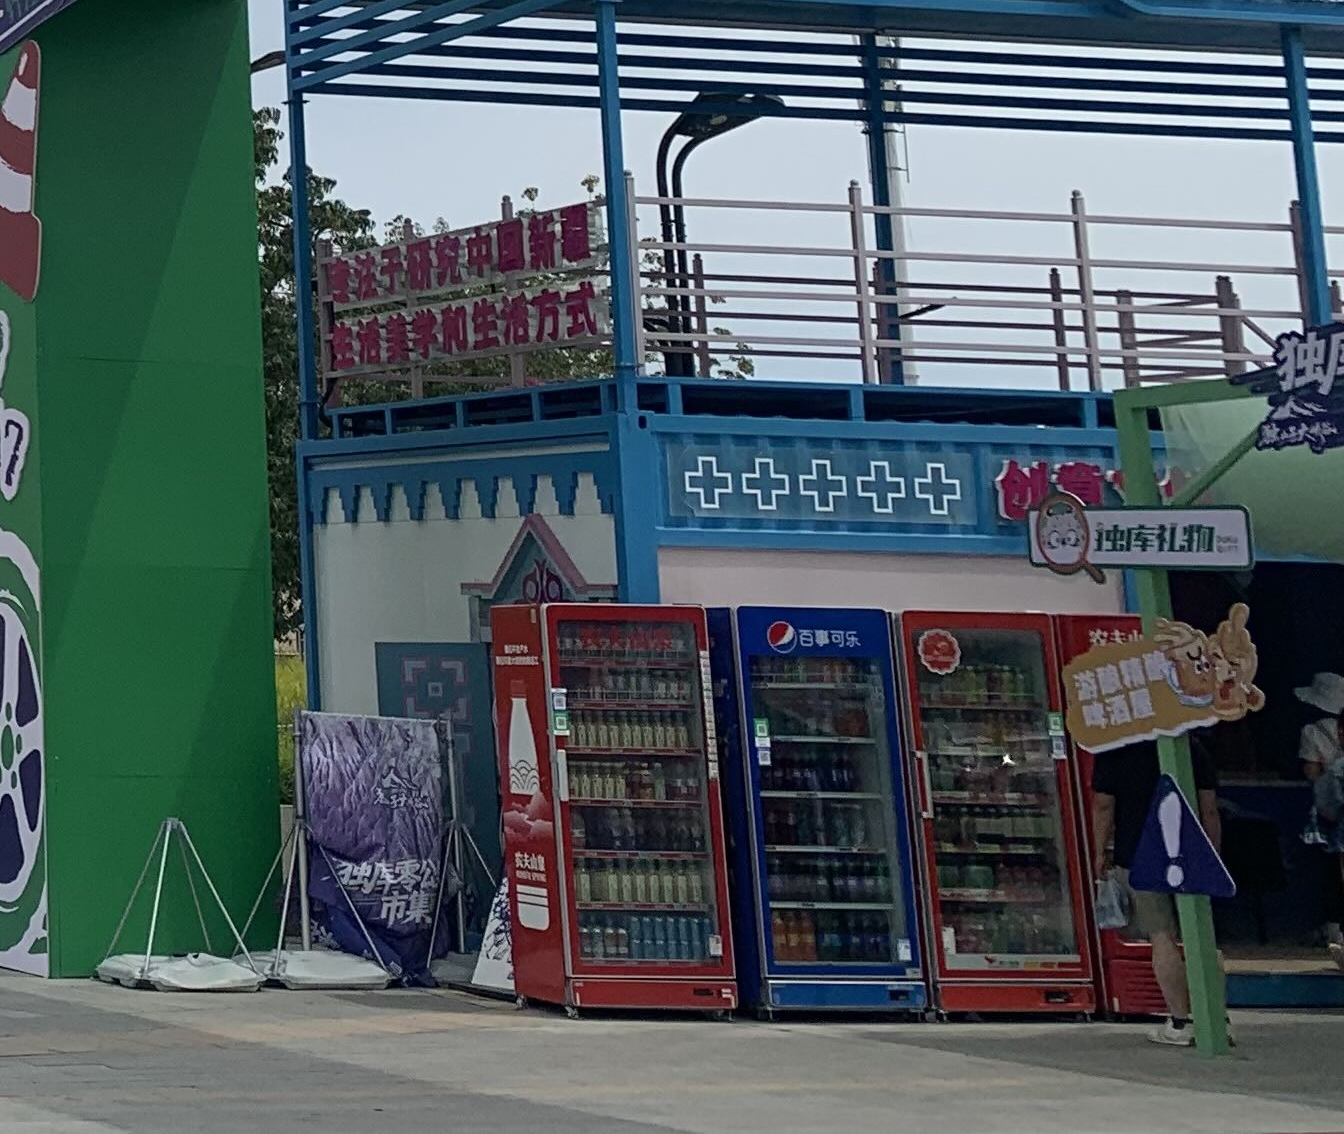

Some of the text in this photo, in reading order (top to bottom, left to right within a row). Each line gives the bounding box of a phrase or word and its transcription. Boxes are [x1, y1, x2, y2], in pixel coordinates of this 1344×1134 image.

[1094, 524, 1216, 553] 独库礼物
[799, 629, 861, 647] 百事可乐
